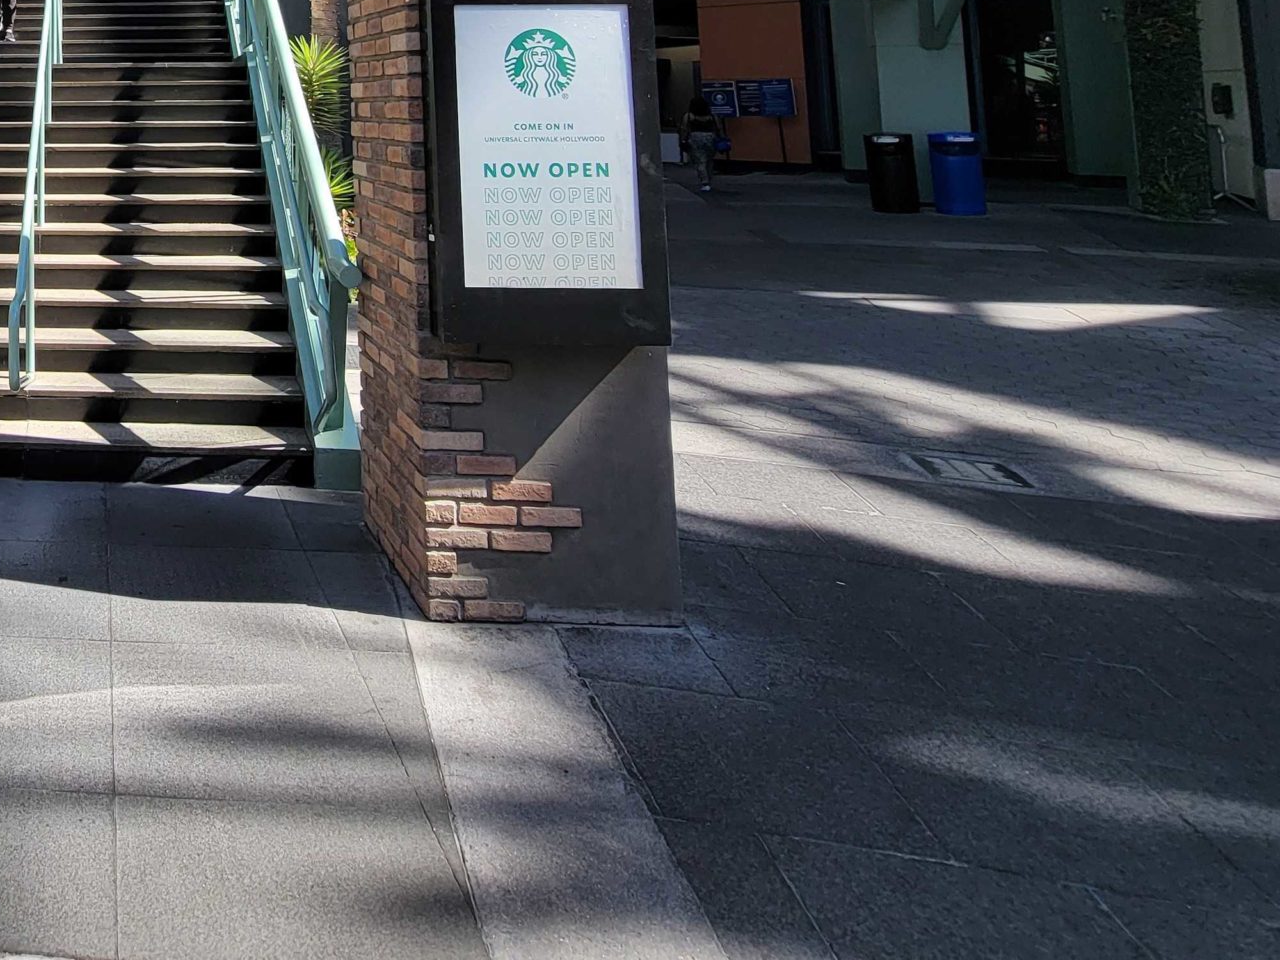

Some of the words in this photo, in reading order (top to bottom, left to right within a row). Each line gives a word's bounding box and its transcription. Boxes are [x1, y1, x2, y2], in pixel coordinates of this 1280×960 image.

[484, 163, 539, 177] NOW
[549, 163, 609, 177] OPEN
[484, 187, 542, 203] NOW
[550, 187, 612, 203] OPEN
[485, 209, 543, 225] NOW
[551, 209, 613, 225] OPEN
[487, 232, 544, 248] NOW
[552, 232, 614, 248] OPEN
[488, 254, 545, 270] NOW
[553, 254, 616, 270] OPEN
